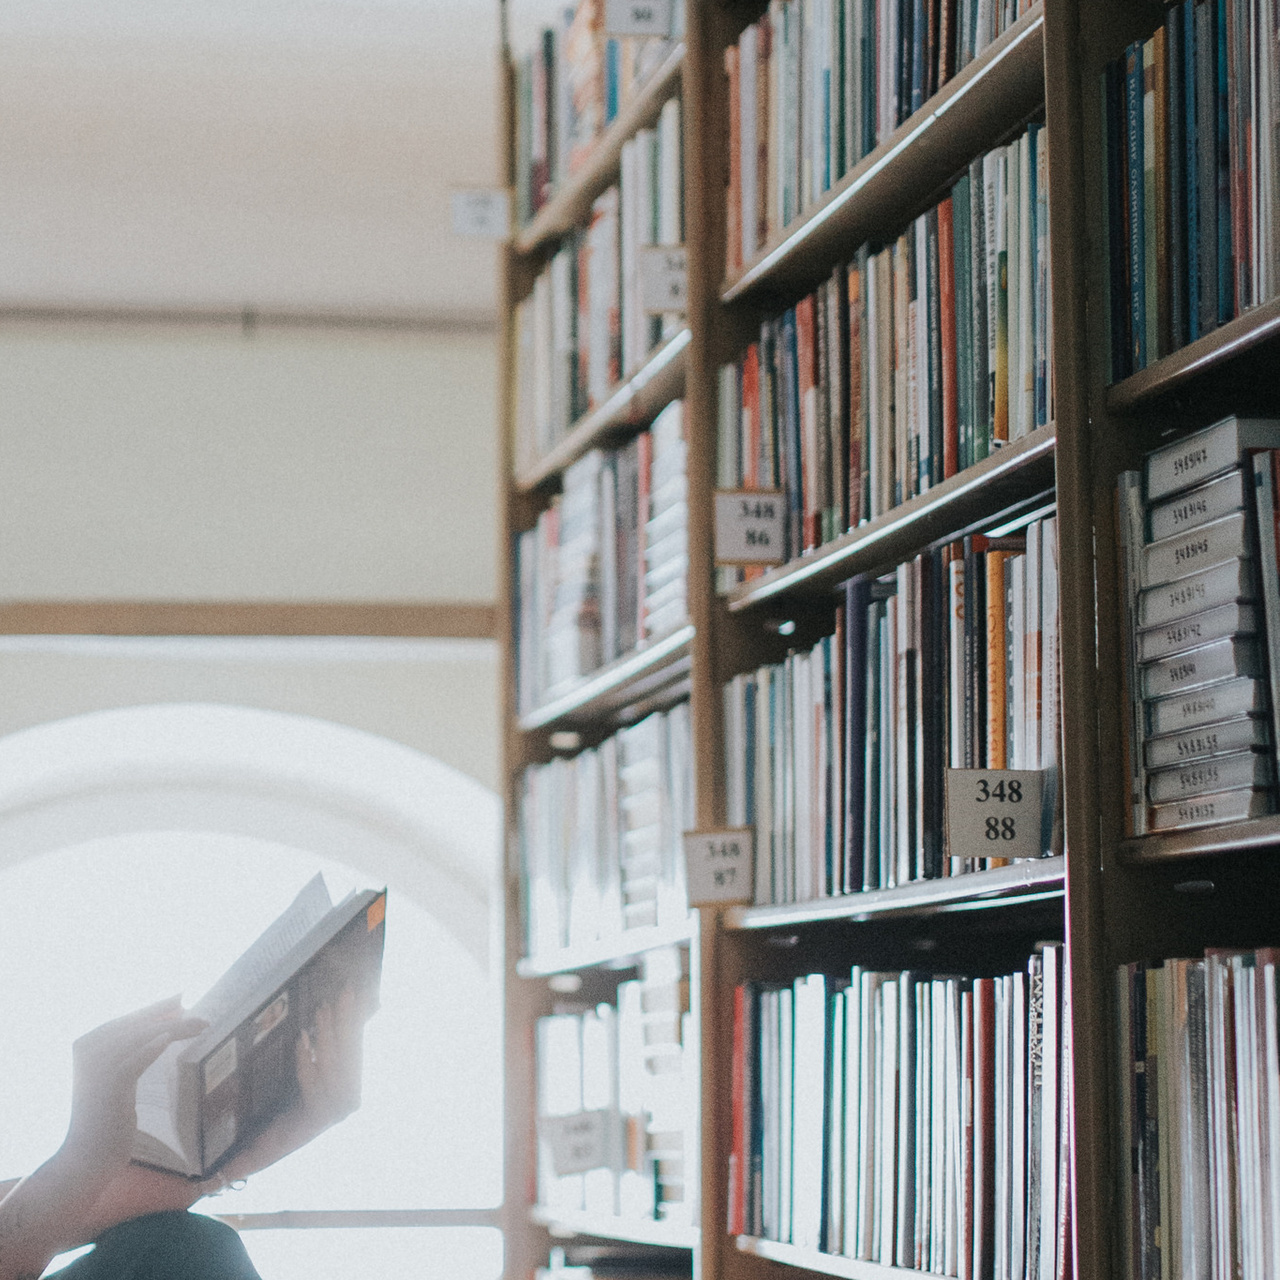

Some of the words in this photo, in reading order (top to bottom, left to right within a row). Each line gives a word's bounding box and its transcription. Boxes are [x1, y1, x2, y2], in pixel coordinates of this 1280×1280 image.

[738, 500, 776, 521] 348
[746, 530, 770, 549] 86
[975, 778, 1023, 804] 348
[984, 815, 1016, 841] 88
